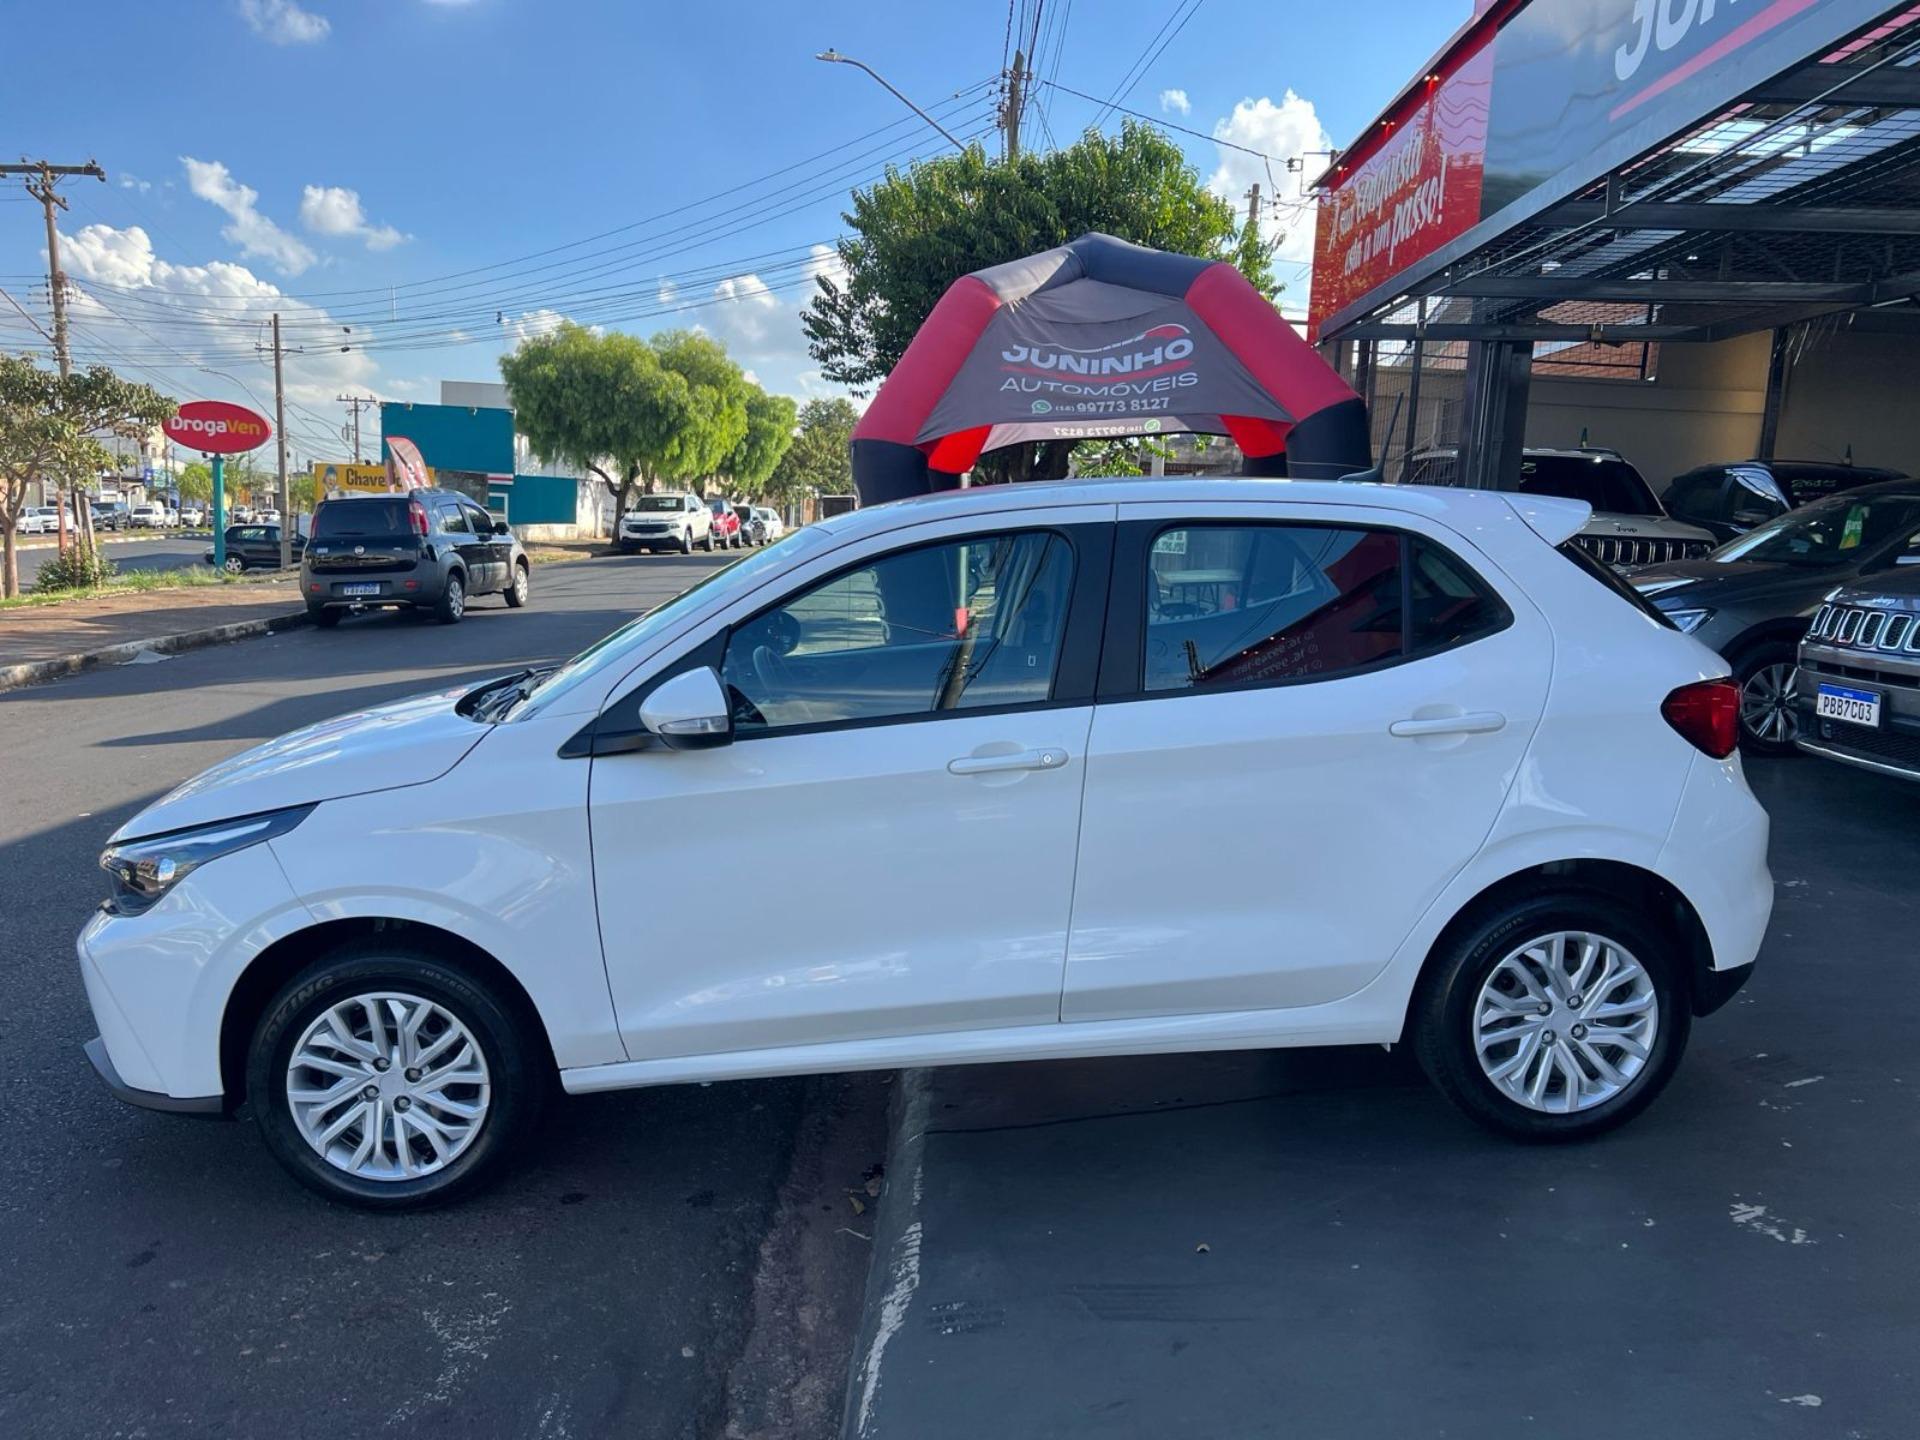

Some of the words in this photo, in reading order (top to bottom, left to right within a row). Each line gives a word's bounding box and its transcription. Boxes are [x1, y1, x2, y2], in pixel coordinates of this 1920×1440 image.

[1355, 129, 1424, 224] conquista
[1363, 233, 1372, 263] a
[1372, 220, 1392, 257] um
[1389, 153, 1447, 267] passo!
[1002, 338, 1194, 375] JUNINHO
[1000, 372, 1199, 397] AUTOMÓVEIS
[1077, 400, 1126, 413] 99773
[1131, 397, 1170, 411] 8127
[170, 416, 260, 437] DrogaVen
[346, 468, 385, 487] Chave
[1823, 696, 1872, 721] PBB7C03
